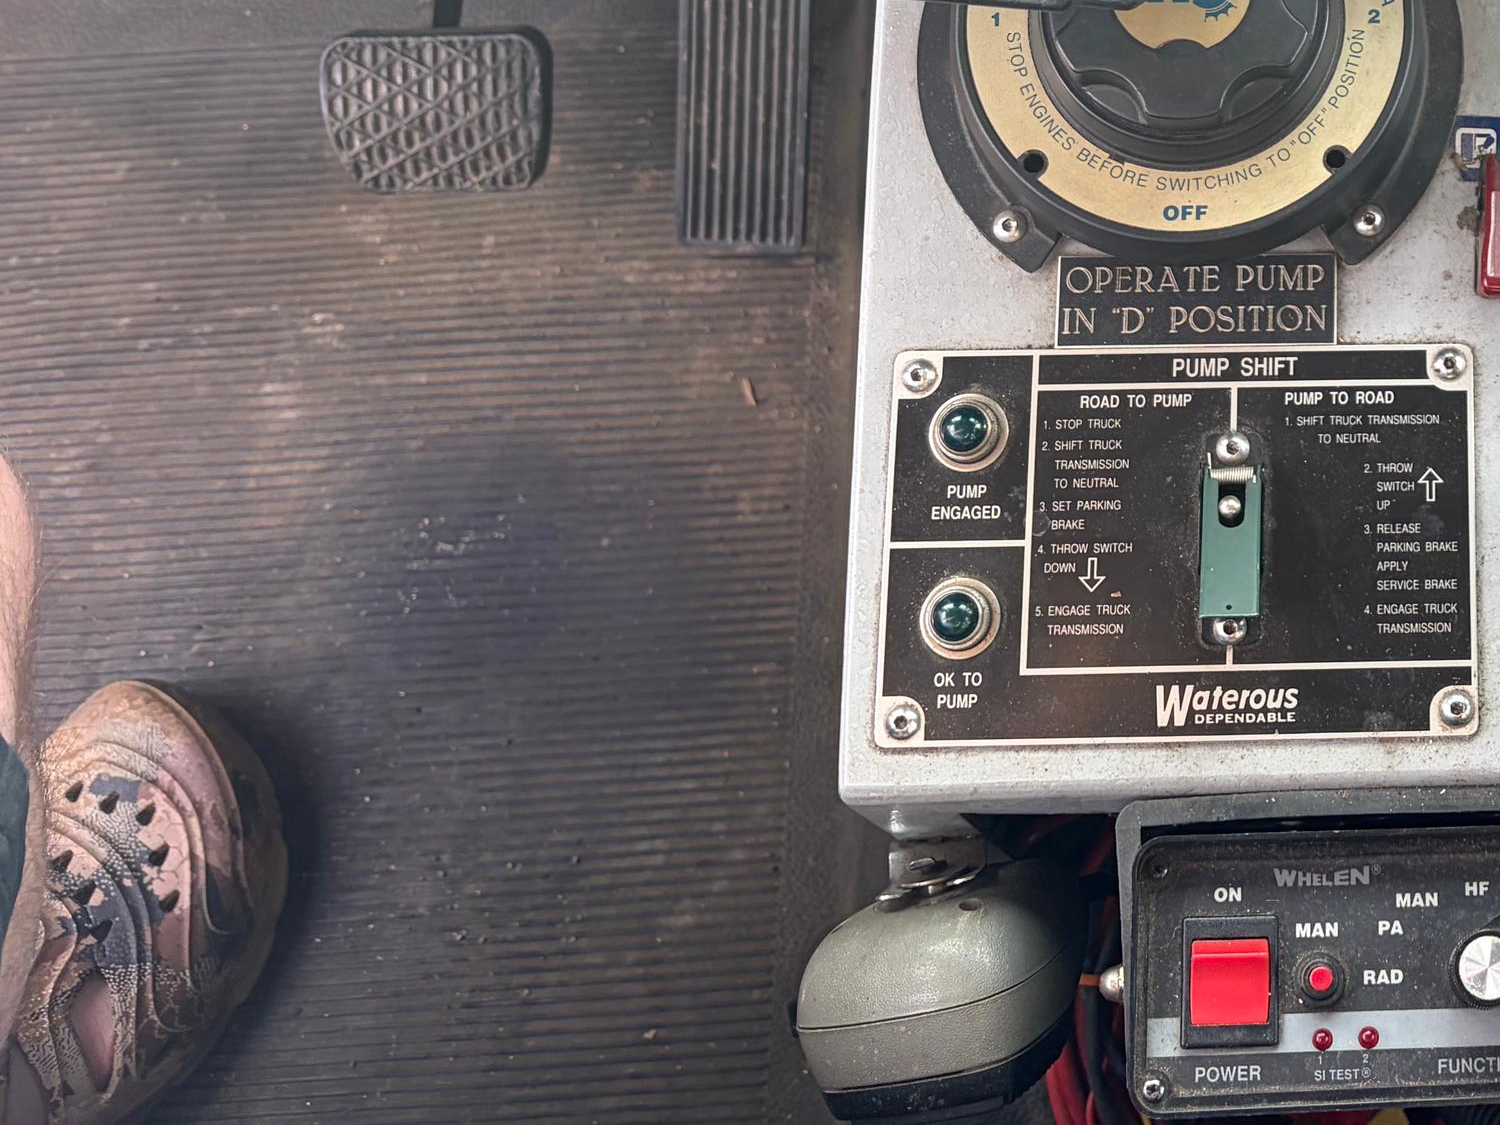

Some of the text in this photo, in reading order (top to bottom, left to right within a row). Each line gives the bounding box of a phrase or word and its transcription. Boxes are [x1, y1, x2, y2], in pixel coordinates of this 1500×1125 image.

[991, 11, 1000, 26] 1
[1368, 8, 1380, 24] 2
[1006, 31, 1028, 78] STOP
[1019, 82, 1076, 151] ENGINES
[1076, 147, 1149, 187] BEFORE
[1155, 163, 1263, 191] SWITCHING
[1266, 148, 1291, 169] TO
[1328, 28, 1365, 110] POSITION
[1163, 205, 1208, 221] OFF
[1066, 264, 1325, 294] OPERATE PUMP
[1061, 307, 1097, 335] IN
[1169, 305, 1327, 333] POSITION
[1172, 356, 1298, 377] PUMP SHIFT
[1080, 393, 1192, 408] ROAD TO PUMP
[1284, 391, 1394, 406] PUMP TO ROAD
[1055, 418, 1121, 430] STOP TRUCK
[1296, 414, 1440, 426] SHIFT TRUCK TRANSMISSION
[1318, 433, 1381, 444] TO NEUTRAL
[1054, 439, 1122, 451] SHIFT TRUCK
[1055, 459, 1130, 470] TRANSMISSION
[1377, 463, 1413, 473] THROW
[1054, 477, 1119, 489] TO NEUTRAL
[1376, 481, 1415, 492] SWITCH
[947, 484, 987, 499] PUMP
[1051, 500, 1121, 511] SET PARKING
[1377, 500, 1391, 511] UP
[931, 505, 1001, 520] ENGAGED
[1051, 519, 1085, 530] BRAKE
[1376, 523, 1421, 534] RELEASE
[1051, 542, 1133, 553] THROW SWITCH
[1376, 541, 1458, 553] PARKING BRAKE
[1044, 562, 1076, 573] DOWN
[1376, 561, 1408, 572] APPLY
[1376, 579, 1458, 590] SERVICE BRAKE
[1048, 604, 1131, 616] ENGAGE TRUCK
[1376, 603, 1458, 615] ENGAGE TRUCK
[1047, 624, 1124, 635] TRANSMISSION
[1377, 622, 1452, 633] TRANSMISSION
[934, 672, 982, 687] OK TO
[936, 694, 978, 709] PUMP
[1156, 684, 1299, 727] Waterous
[1194, 712, 1296, 724] DEPENDABLE
[1214, 887, 1242, 902] ON
[1464, 881, 1490, 896] HF
[1395, 892, 1439, 908] MAN
[1295, 922, 1339, 938] MAN
[1378, 920, 1403, 936] PA
[1363, 969, 1404, 985] RAD
[1195, 1065, 1261, 1083] POWER
